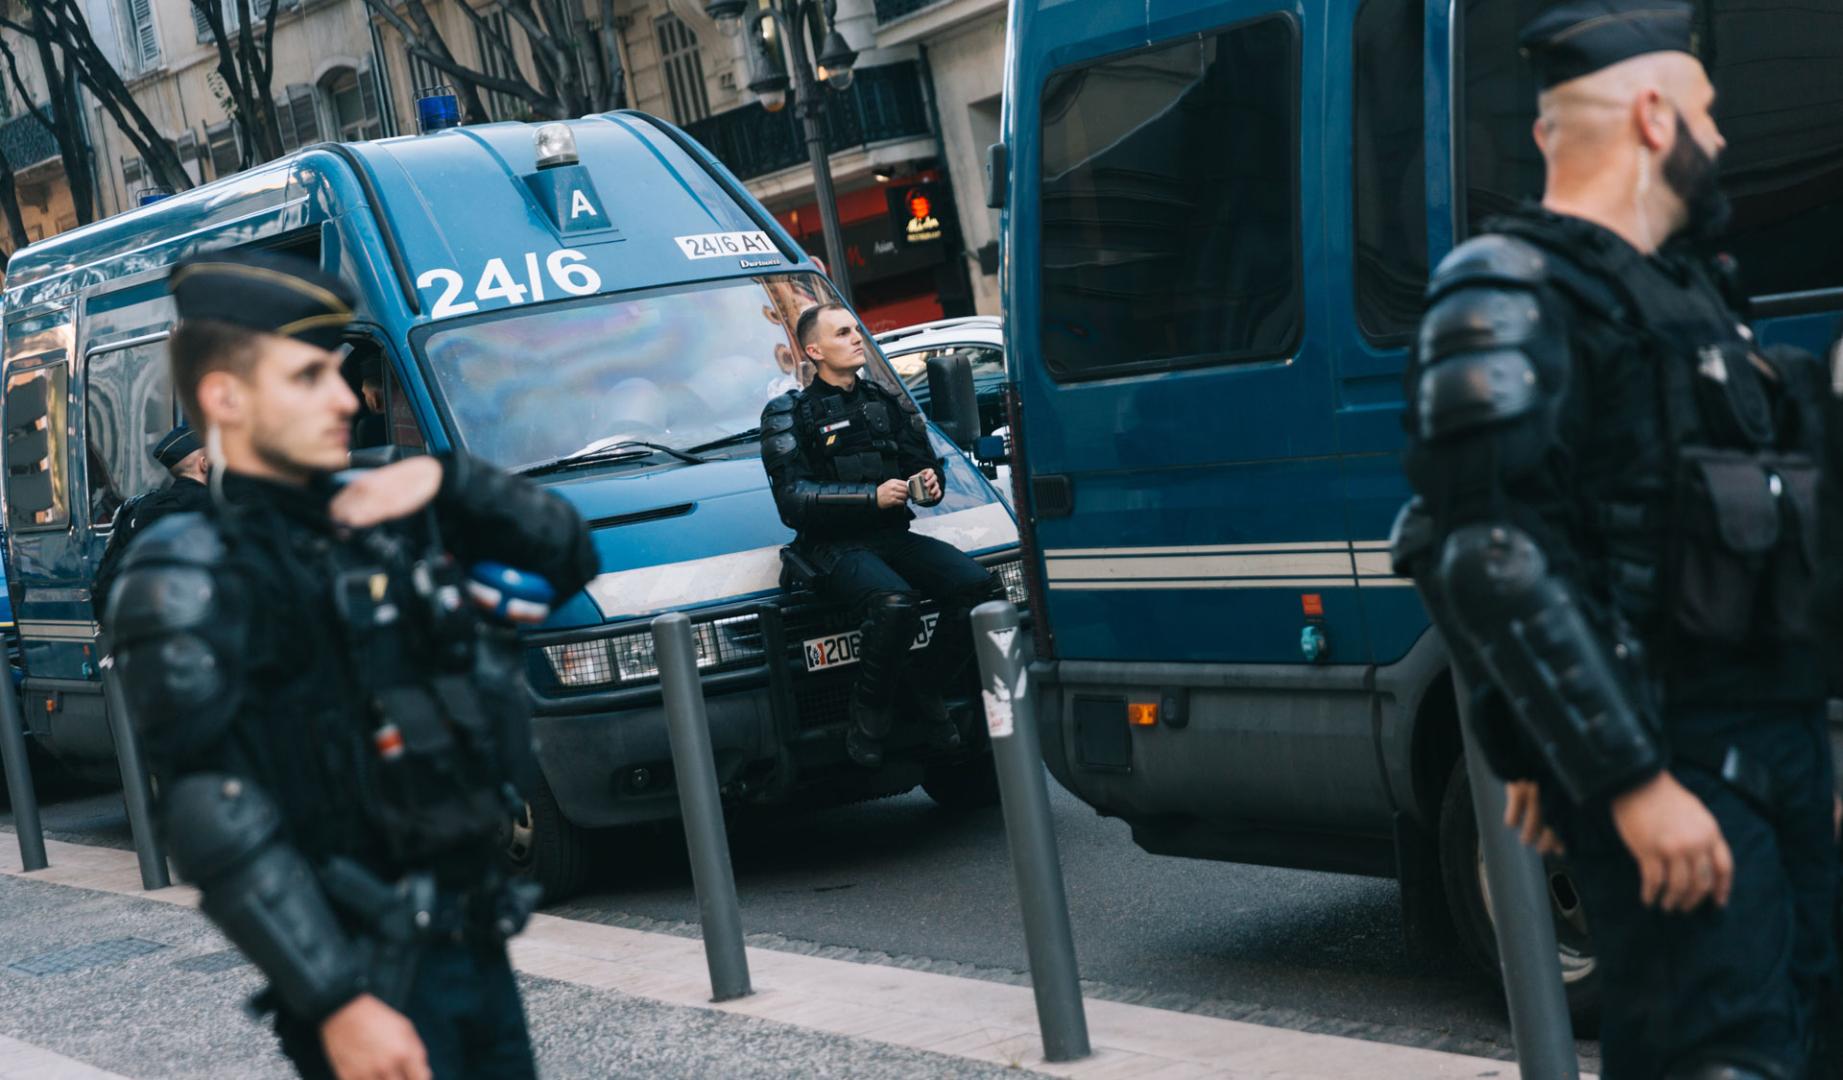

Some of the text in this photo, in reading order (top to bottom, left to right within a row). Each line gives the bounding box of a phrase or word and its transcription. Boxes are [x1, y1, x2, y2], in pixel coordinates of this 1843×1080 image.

[571, 189, 597, 219] A
[686, 234, 770, 256] 24/6 A1
[417, 249, 601, 320] 24/6
